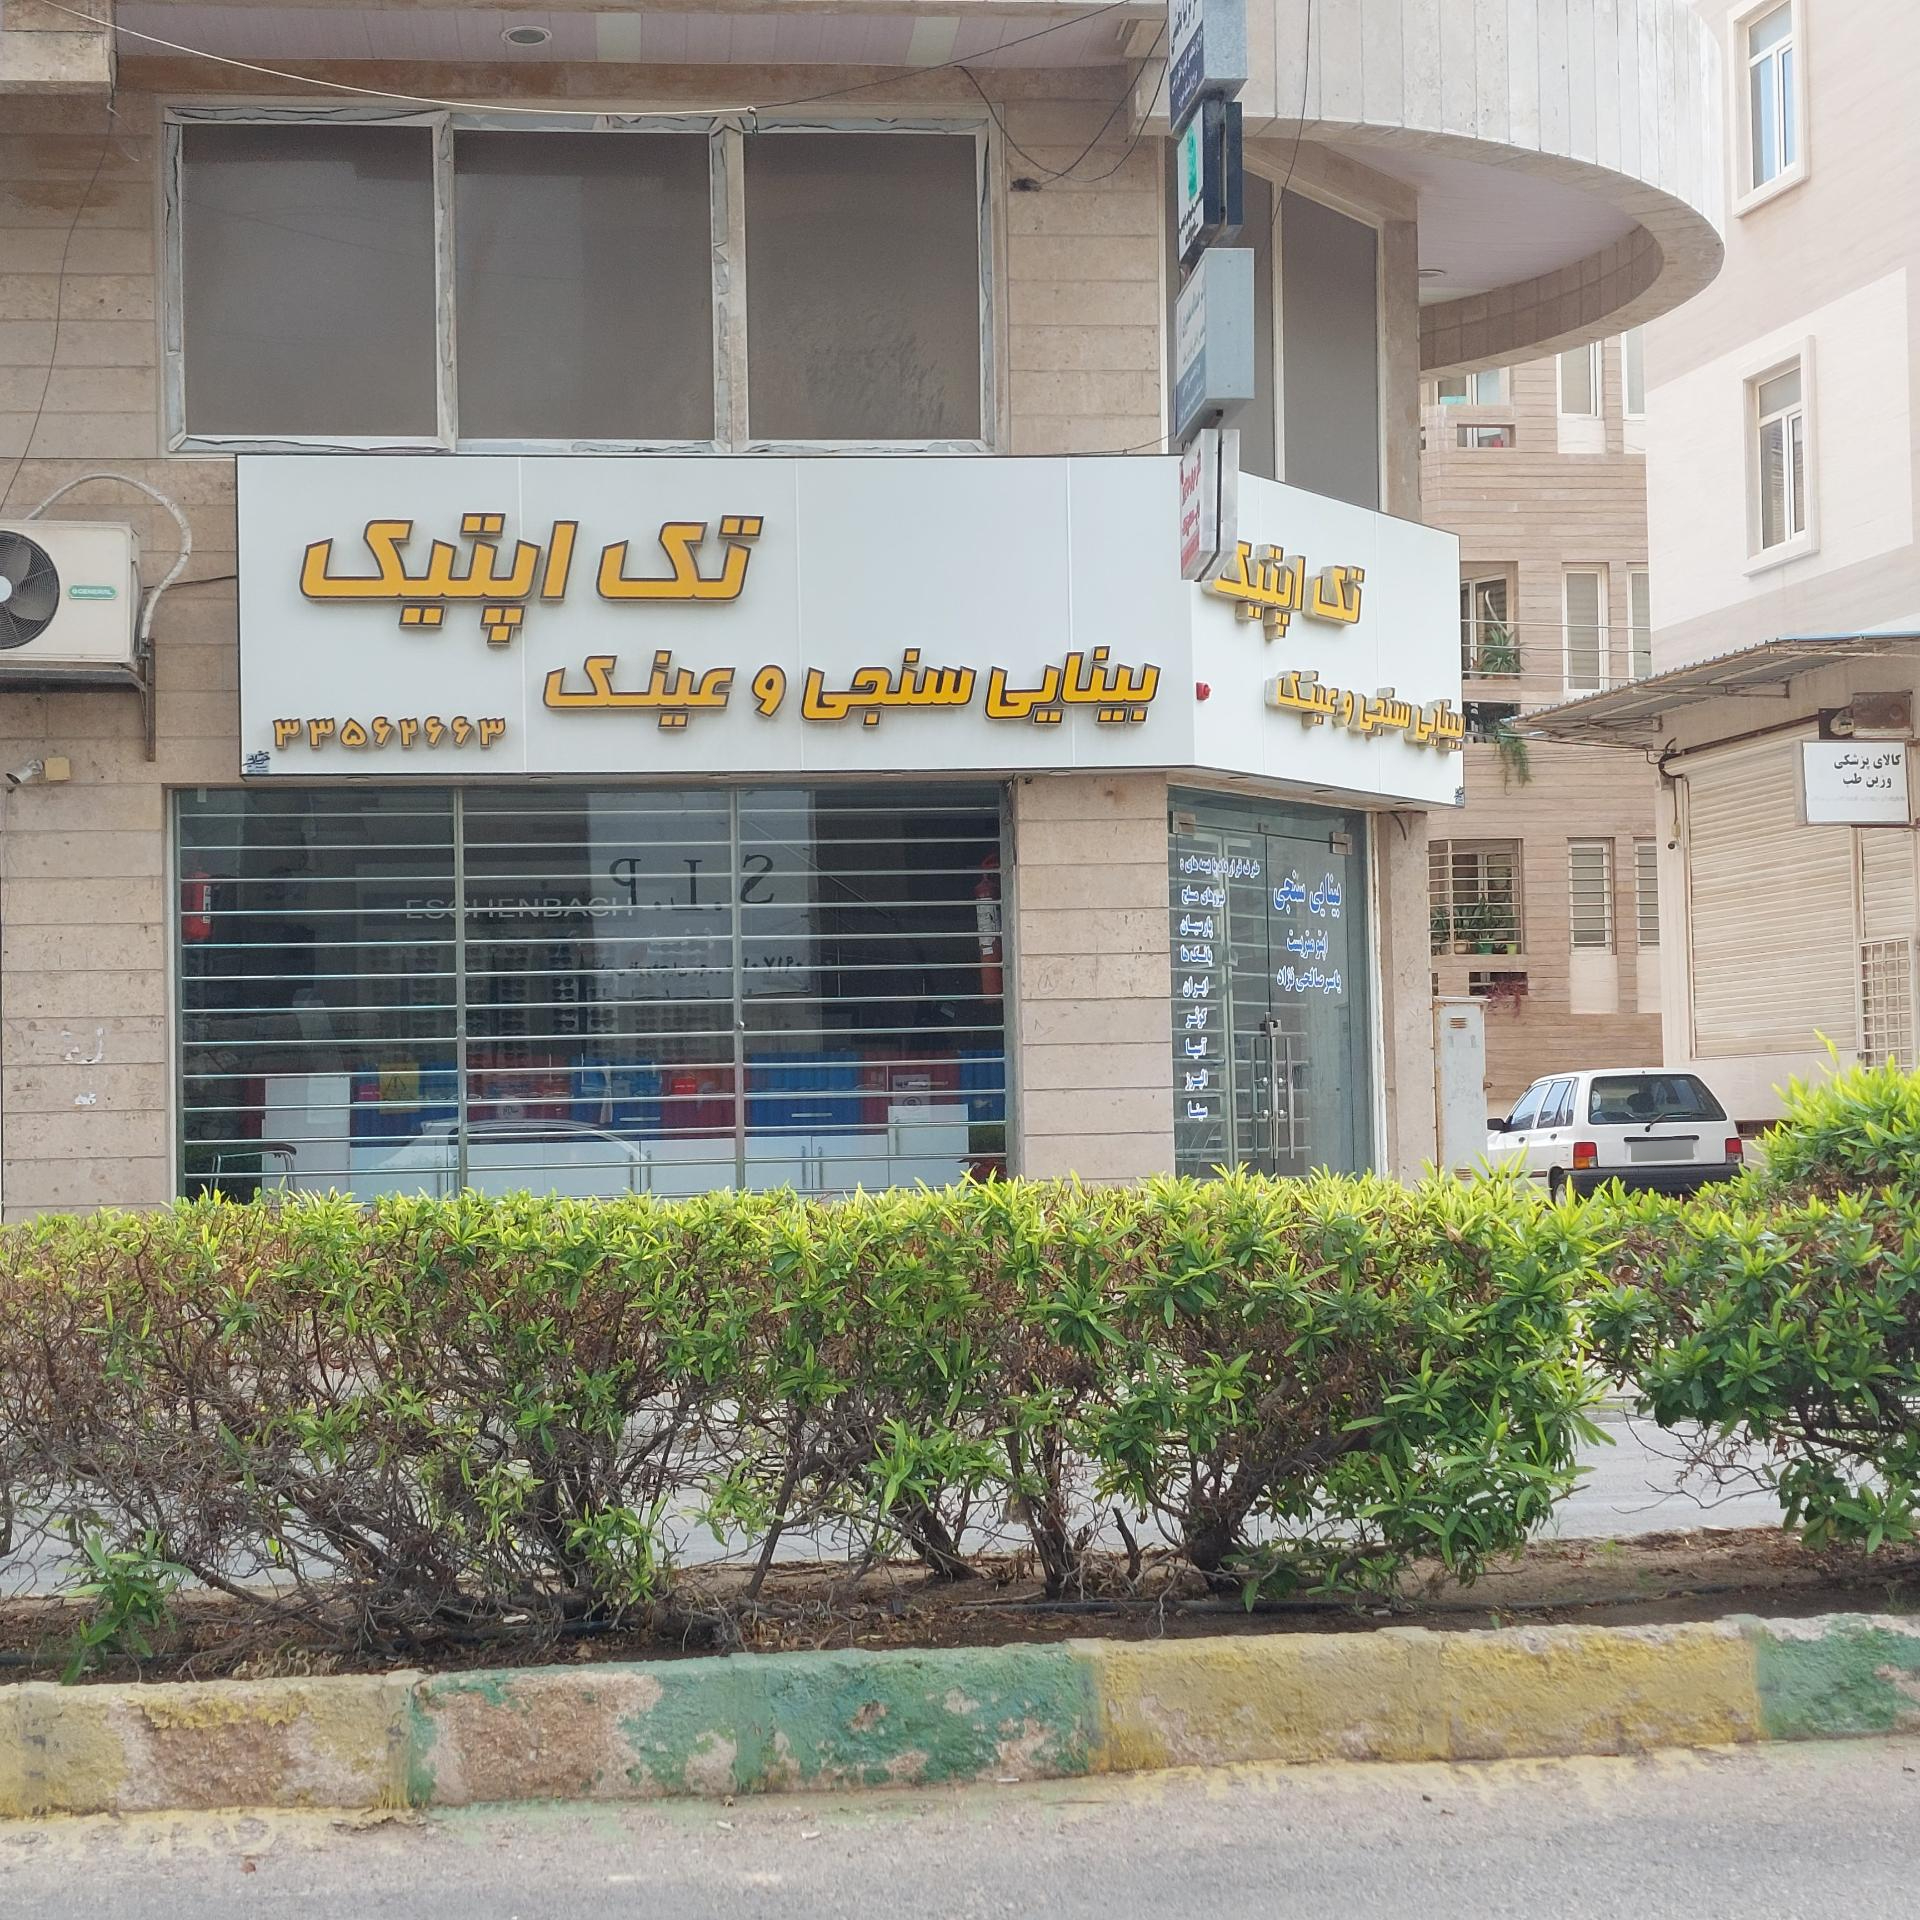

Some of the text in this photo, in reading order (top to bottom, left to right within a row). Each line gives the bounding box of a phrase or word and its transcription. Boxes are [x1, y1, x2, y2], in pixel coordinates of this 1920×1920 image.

[300, 513, 764, 644] تک اپتیک
[1308, 565, 1365, 624] تک
[544, 645, 1161, 729] بینایی سنجی و عینک
[1269, 670, 1466, 751] بینایی سنجی و عینک
[272, 714, 507, 749] ۳۳۵۶۲۶۶۳
[1833, 753, 1901, 770] کالای پزشکی
[1842, 772, 1862, 788] طب
[1182, 884, 1200, 905] مسلح
[1274, 869, 1342, 918] بینایی سنجی
[1180, 913, 1214, 939] پارسیان
[1182, 975, 1209, 998] ایران
[1185, 1005, 1208, 1029] کوثر
[1185, 1037, 1208, 1059] آسیا
[1185, 1068, 1209, 1091] البرز
[1187, 1100, 1208, 1122] سینا
